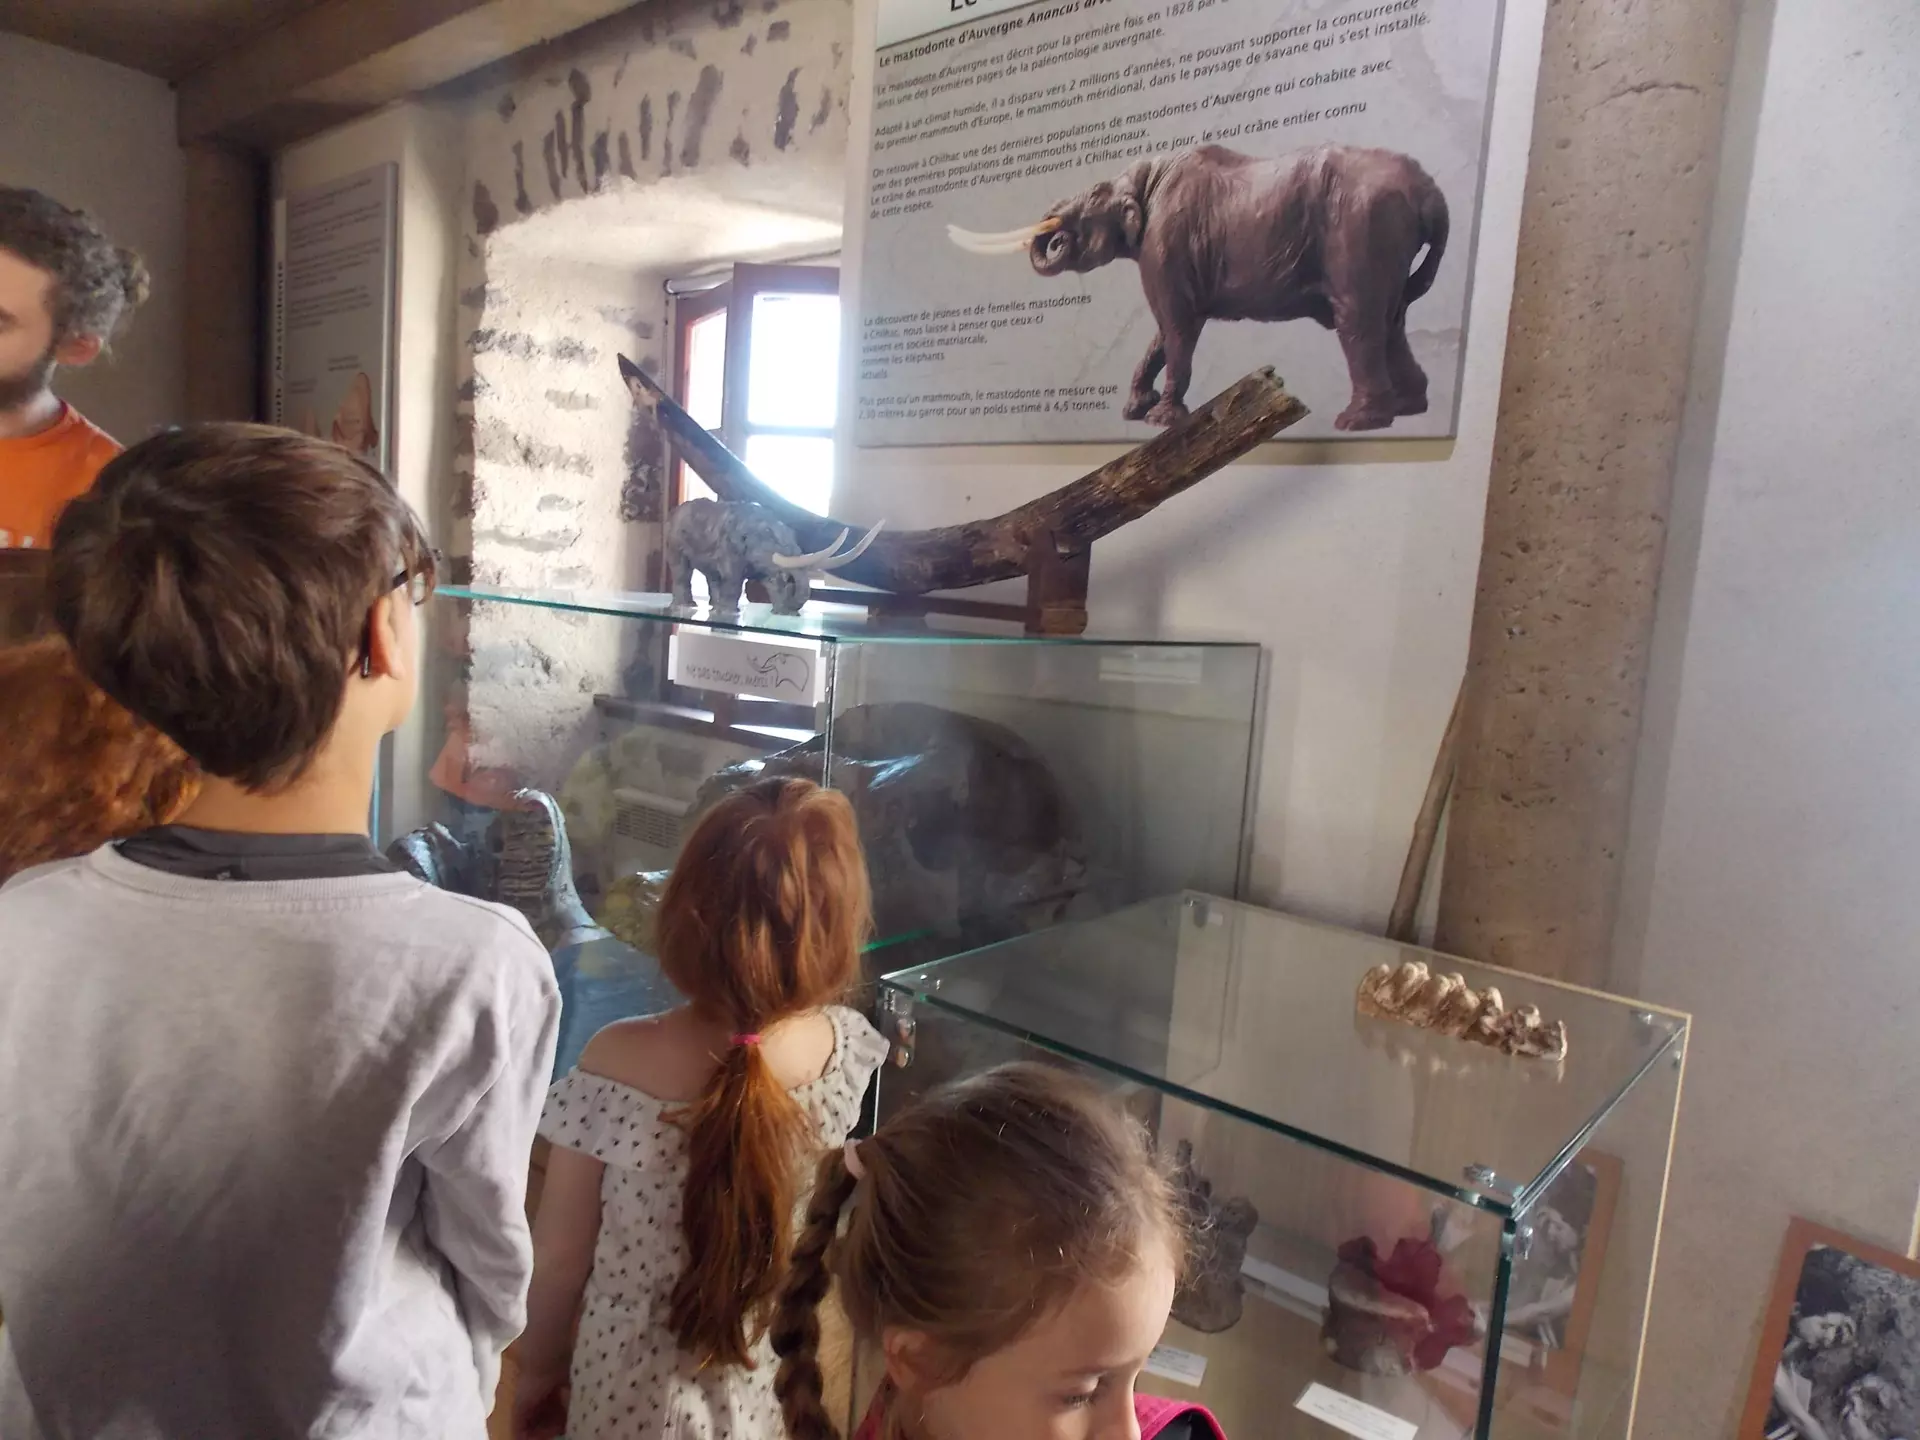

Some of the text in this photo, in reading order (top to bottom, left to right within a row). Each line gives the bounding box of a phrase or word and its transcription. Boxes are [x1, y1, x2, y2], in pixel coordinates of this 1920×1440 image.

[877, 85, 886, 96] Le
[888, 73, 937, 93] mastodonte
[939, 59, 988, 79] d'Auvergne
[990, 53, 1004, 65] est
[1006, 46, 1033, 61] décrit
[1035, 40, 1059, 56] pour
[1062, 35, 1071, 46] la
[1074, 24, 1120, 46] première
[1124, 17, 1144, 29] fois
[1147, 12, 1160, 22] en
[1166, 1, 1194, 17] 1828
[879, 55, 890, 67] Le
[893, 38, 955, 63] mastodonte
[958, 19, 1024, 44] d'Auvergne
[1027, 3, 1080, 25] Anancus
[874, 0, 1419, 137] Adapté à un climat humide, il a disparu vers 2 millions d'années, ne pouvant supporter la concurrence
[875, 14, 1431, 151] du premier mammouth d'Europe, le mammouth méridional, dans le paysage de savane qui s'est installé.
[898, 93, 912, 104] une
[914, 88, 928, 99] des
[931, 77, 974, 98] premières
[976, 71, 1003, 86] pages
[1005, 65, 1017, 76] de
[1020, 61, 1028, 72] la
[1031, 45, 1099, 71] paléontologie
[1102, 29, 1165, 51] auvergnate.
[873, 62, 1393, 178] On retrouve à Chilhac une des dernières populations de mastodontes d'Auvergne qui cohabite avec
[871, 104, 1366, 205] Le crâne de mastodonte d'Auvergne découvert à Chilhac est à ce jour, le seul crâne entier connu
[872, 130, 1150, 191] une des premières populations de mammouths méridionaux.
[870, 199, 934, 219] de cette espèce.
[875, 313, 918, 325] découverte
[921, 310, 931, 320] de
[933, 309, 960, 322] jeunes
[963, 307, 971, 316] et
[974, 305, 985, 315] de
[988, 301, 1025, 313] femelles
[1029, 296, 1092, 309] mastodontes
[904, 327, 923, 337] nous
[926, 324, 949, 334] laisse
[951, 321, 956, 332] à
[959, 321, 988, 333] penser
[991, 319, 1008, 330] que
[891, 354, 903, 364] les
[905, 351, 945, 364] éléphants
[906, 338, 934, 349] société
[937, 334, 988, 347] matriarcale,
[897, 393, 919, 406] qu'un
[922, 390, 973, 403] mammouth,
[976, 390, 984, 400] le
[986, 387, 1041, 399] mastodonte
[1044, 388, 1055, 396] ne
[1058, 387, 1095, 395] mesure
[1098, 386, 1118, 396] que
[920, 406, 944, 419] garrot
[947, 407, 967, 417] pour
[970, 406, 981, 414] un
[984, 403, 1008, 416] poids
[1010, 402, 1041, 413] estimé
[1044, 402, 1050, 412] à
[1053, 401, 1069, 414] 4,5
[1072, 402, 1110, 411] tonnes.
